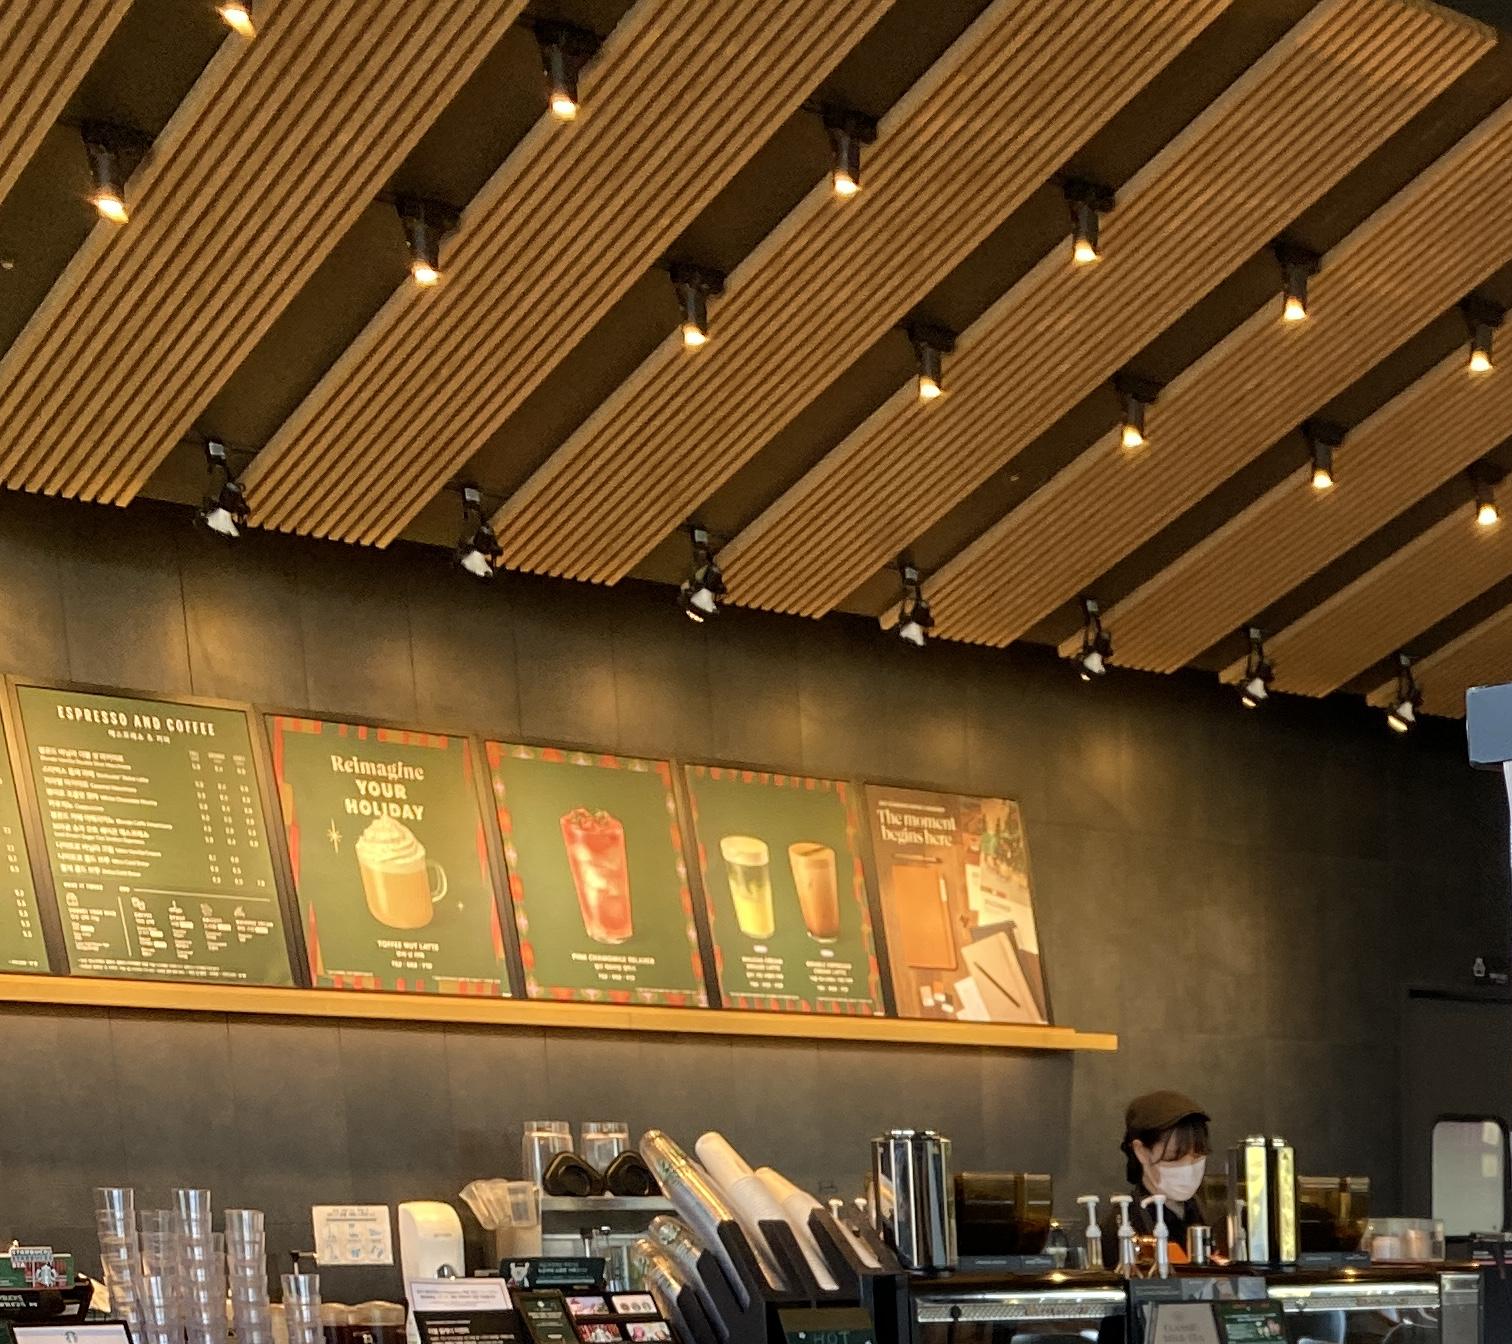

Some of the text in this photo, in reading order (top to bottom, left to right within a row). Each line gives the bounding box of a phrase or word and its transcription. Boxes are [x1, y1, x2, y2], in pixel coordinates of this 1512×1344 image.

[57, 705, 215, 735] ESPRESSO AND COFFEE
[331, 754, 424, 781] Reimagine
[355, 779, 407, 799] YOUR
[344, 798, 424, 820] HOLIDAY
[903, 814, 956, 831] moment
[881, 825, 924, 845] begins
